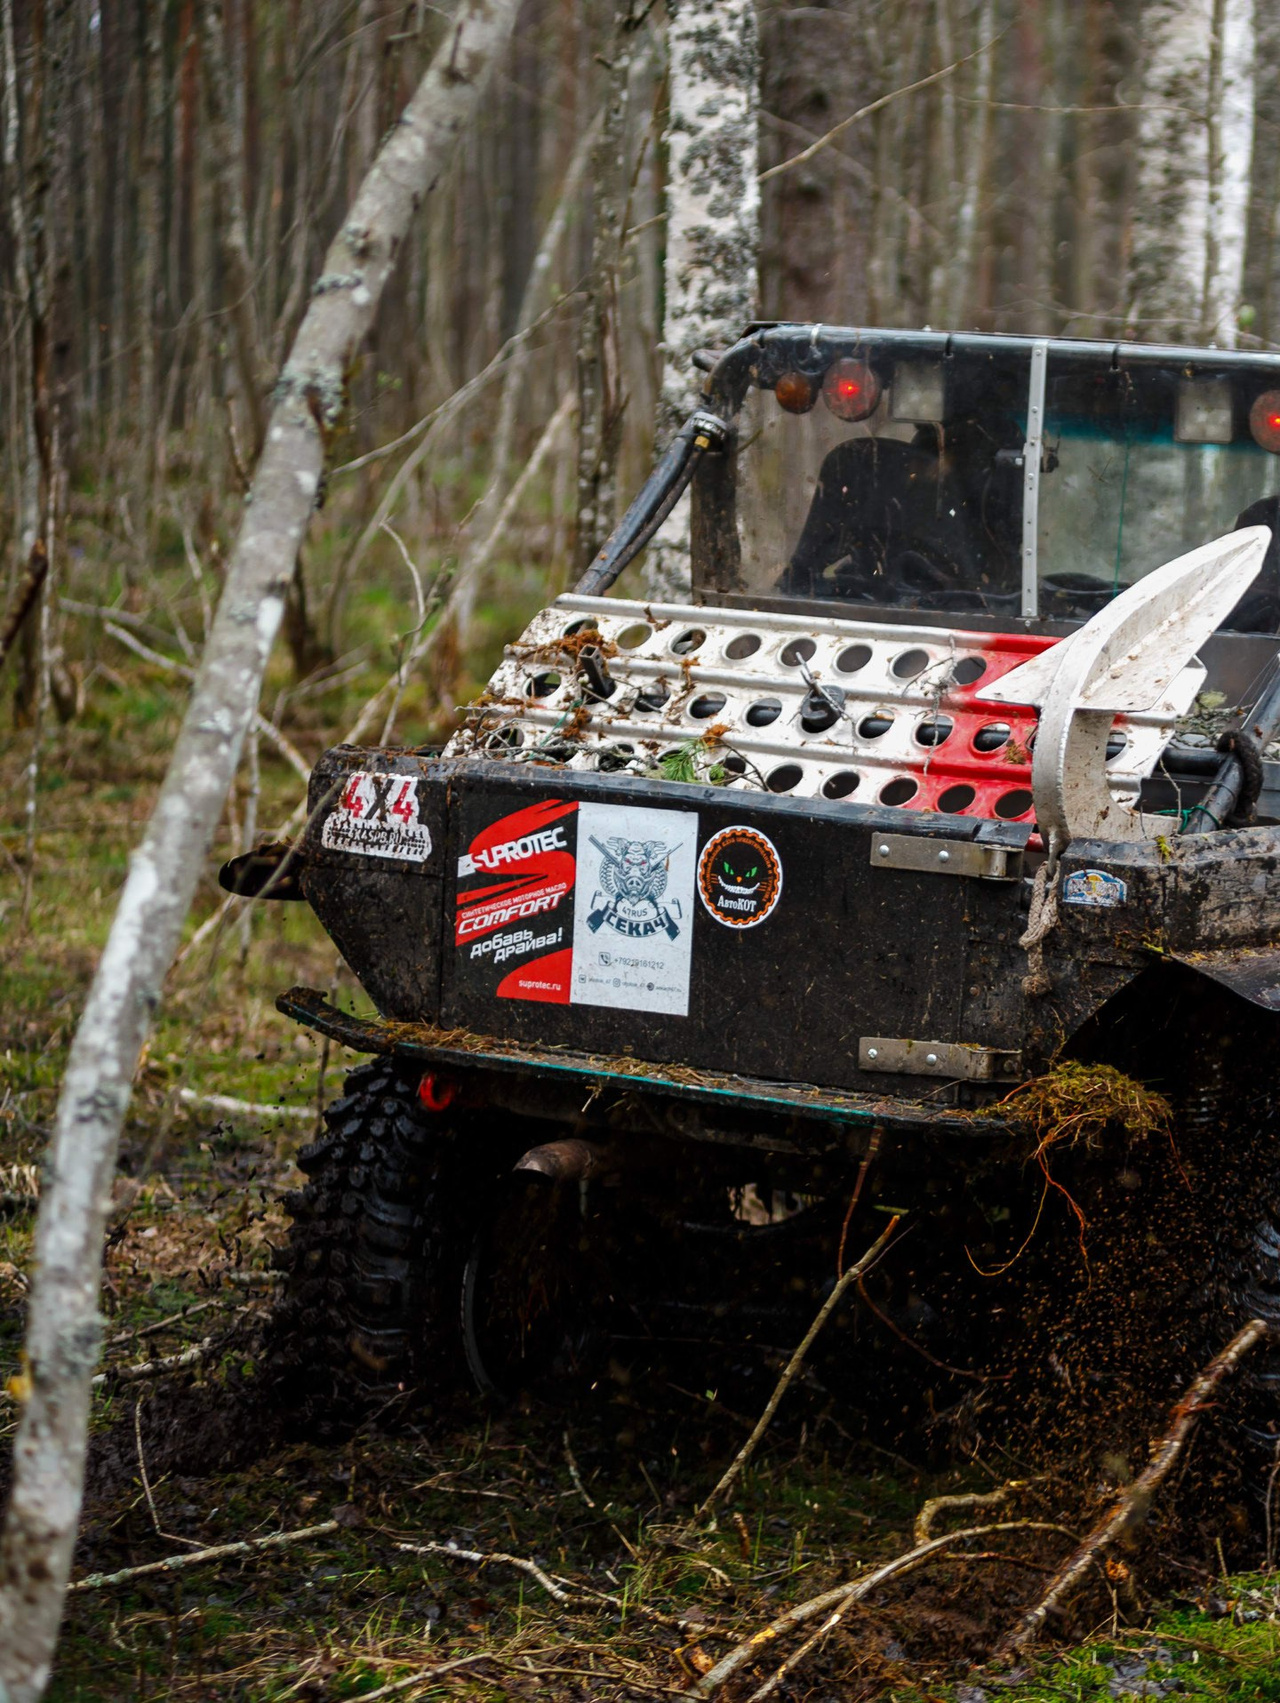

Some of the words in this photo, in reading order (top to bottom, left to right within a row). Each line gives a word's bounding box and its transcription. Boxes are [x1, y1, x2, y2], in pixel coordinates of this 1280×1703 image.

[458, 826, 567, 878] SUPROTEC
[512, 888, 546, 903] МОТОРНОЕ
[545, 882, 567, 895] МАСЛО
[458, 891, 565, 934] COMFORT
[605, 911, 667, 936] СЕКАЧ
[622, 906, 648, 917] 47RUS
[470, 929, 533, 959] добавь
[493, 927, 563, 964] драйва!
[518, 979, 561, 991] suprotec.ru
